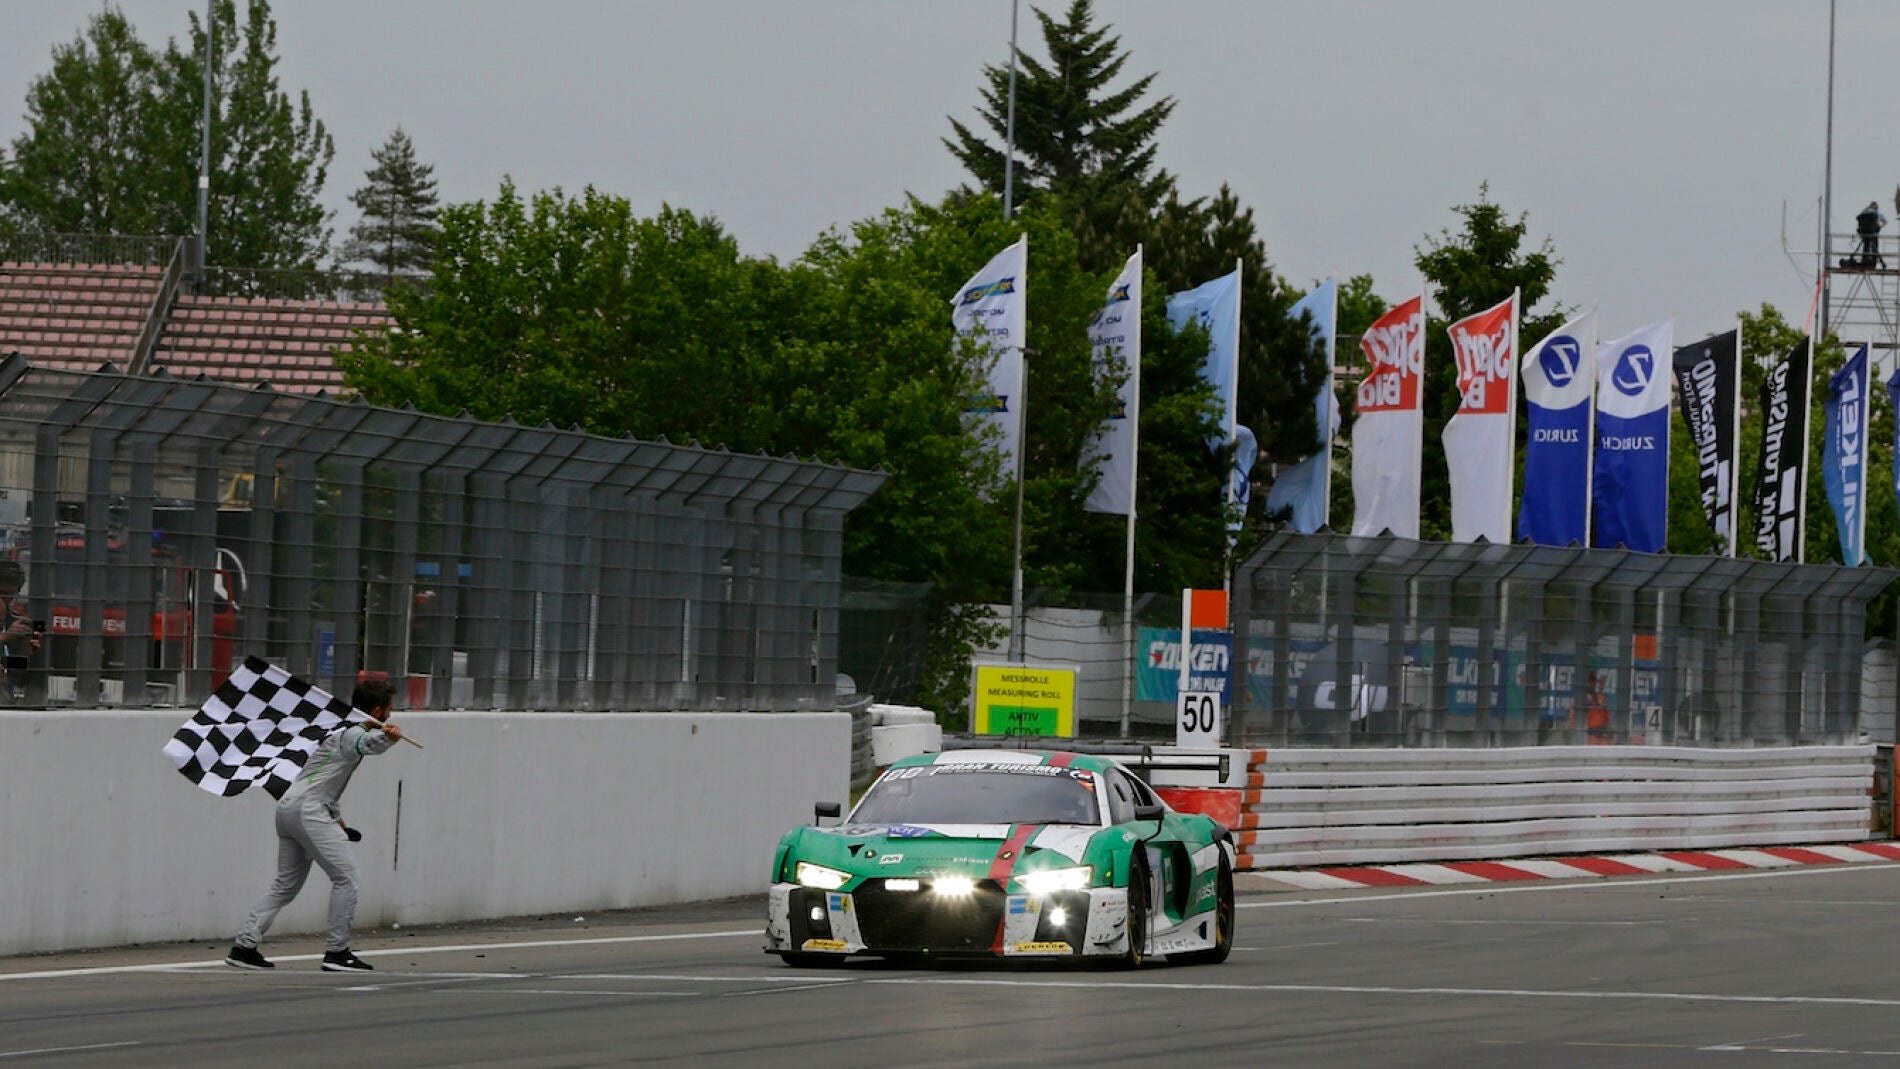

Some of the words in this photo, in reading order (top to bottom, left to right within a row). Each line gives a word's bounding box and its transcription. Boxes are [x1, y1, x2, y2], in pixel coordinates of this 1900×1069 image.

[1001, 674, 1049, 685] MESSROLLE
[987, 687, 1040, 699] MEASURING
[1041, 689, 1061, 700] ROLL
[1008, 711, 1039, 722] AKTIV
[1182, 695, 1214, 733] 50
